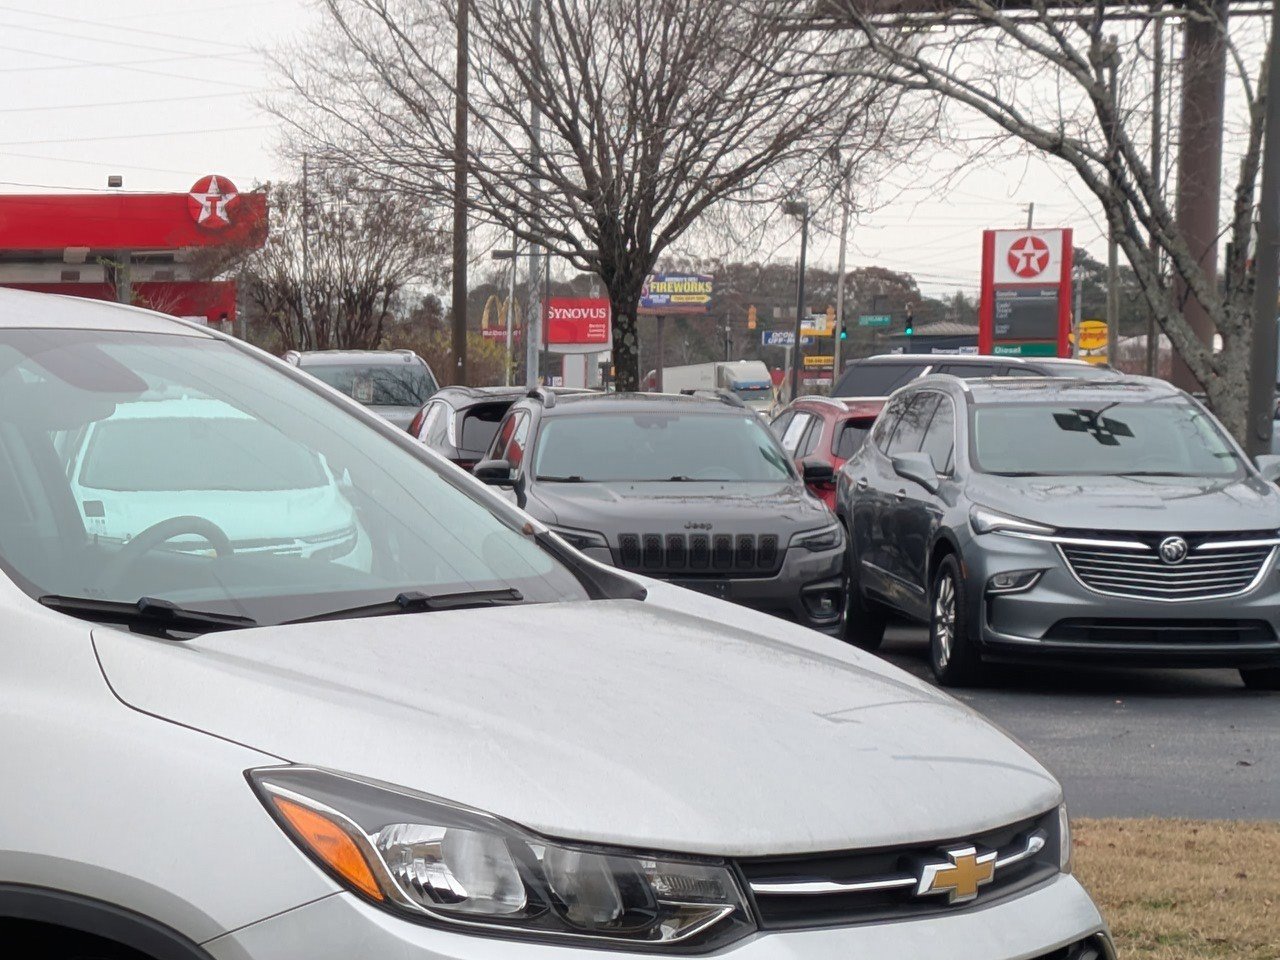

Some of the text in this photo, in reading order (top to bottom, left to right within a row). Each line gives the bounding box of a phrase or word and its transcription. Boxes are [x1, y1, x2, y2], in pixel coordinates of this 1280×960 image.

[650, 281, 713, 293] FIREWORKS
[549, 307, 606, 319] SYNOVUS
[994, 345, 1021, 354] Diesel
